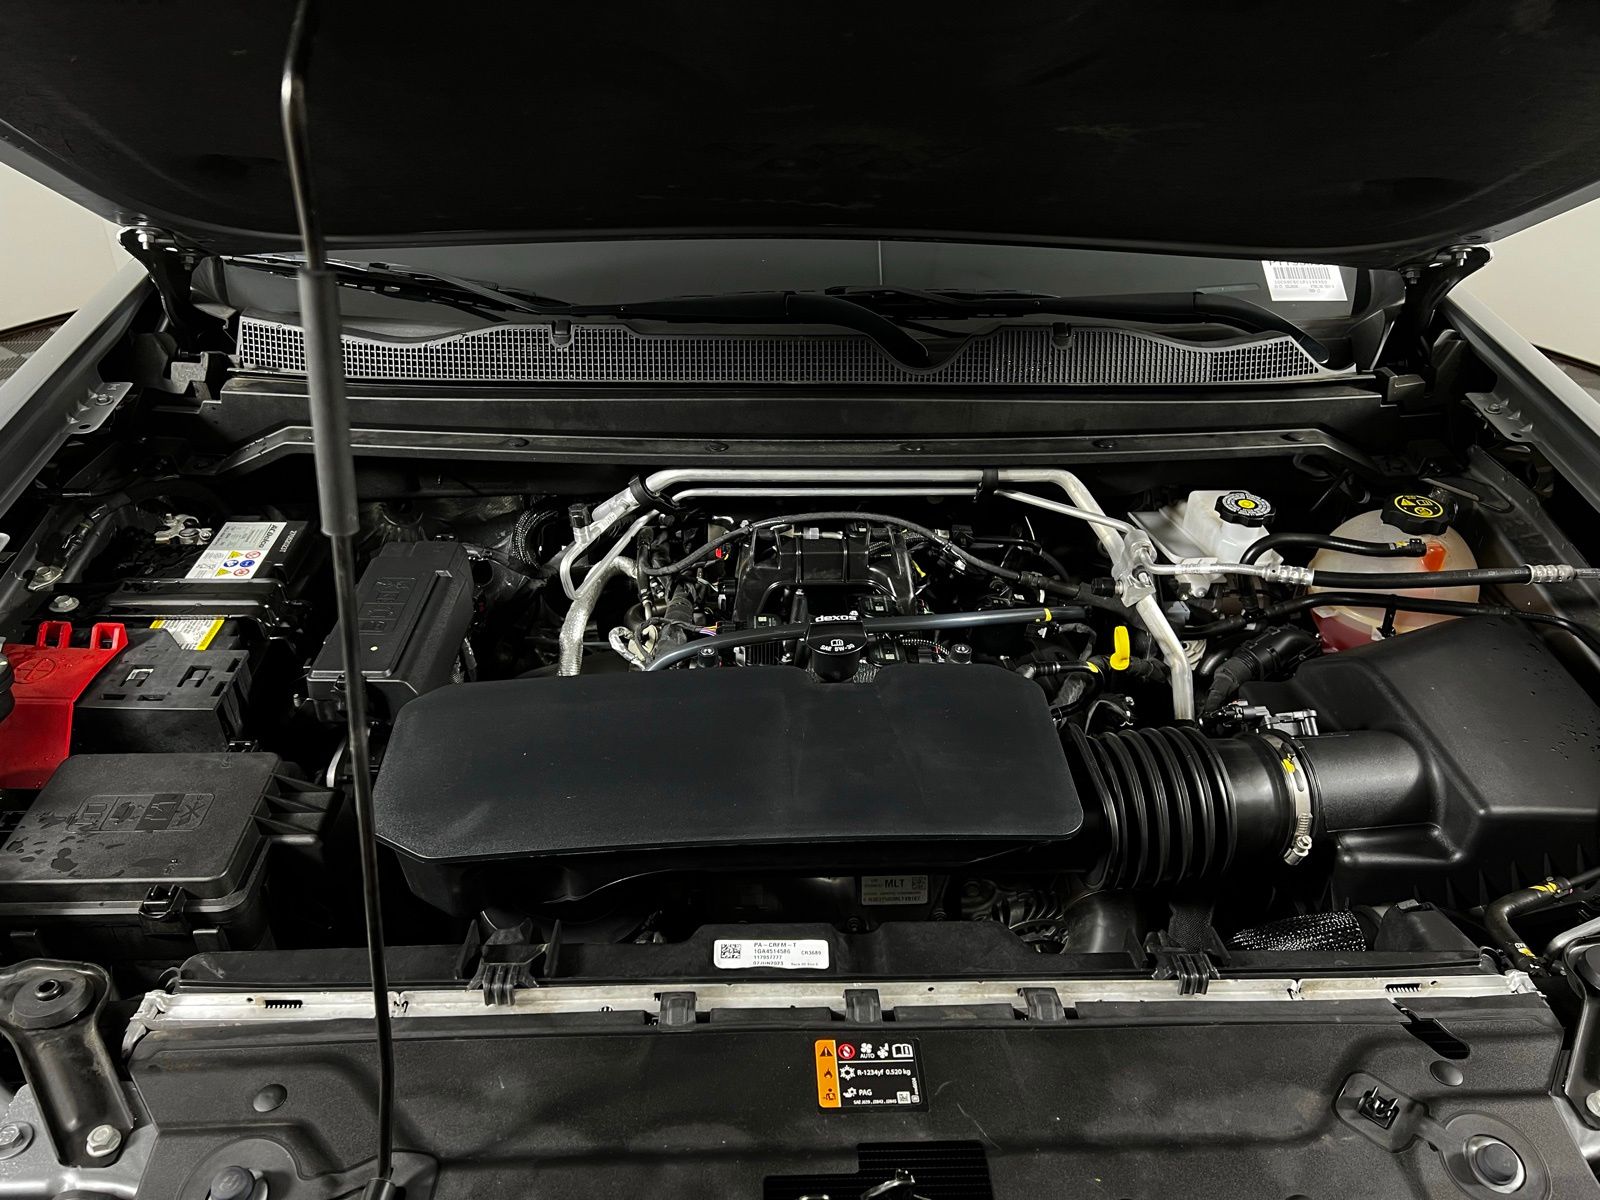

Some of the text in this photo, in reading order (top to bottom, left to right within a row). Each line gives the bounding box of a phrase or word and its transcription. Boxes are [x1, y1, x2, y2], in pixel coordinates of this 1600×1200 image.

[259, 523, 278, 548] ACDelco
[815, 614, 857, 622] dexos
[820, 644, 832, 652] SAE
[884, 878, 904, 888] MLT
[857, 1068, 911, 1077] R-1234yf 0.520 kg
